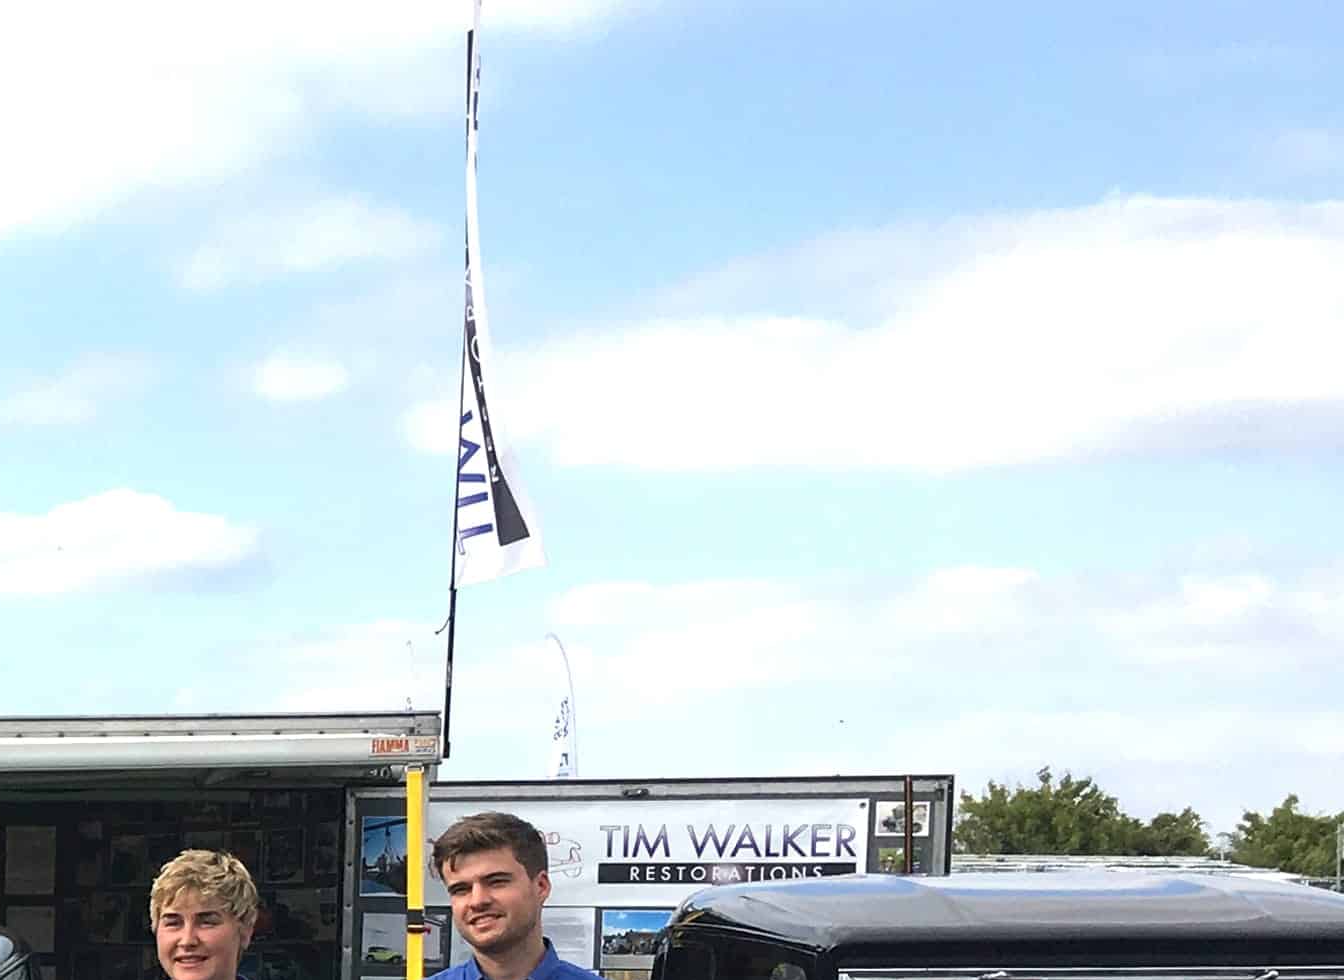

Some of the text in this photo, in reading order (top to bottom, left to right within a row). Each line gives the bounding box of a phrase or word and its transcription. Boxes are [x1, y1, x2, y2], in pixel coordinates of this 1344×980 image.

[600, 823, 856, 858] TIM WALKER
[629, 865, 823, 882] RESTORATIONS
